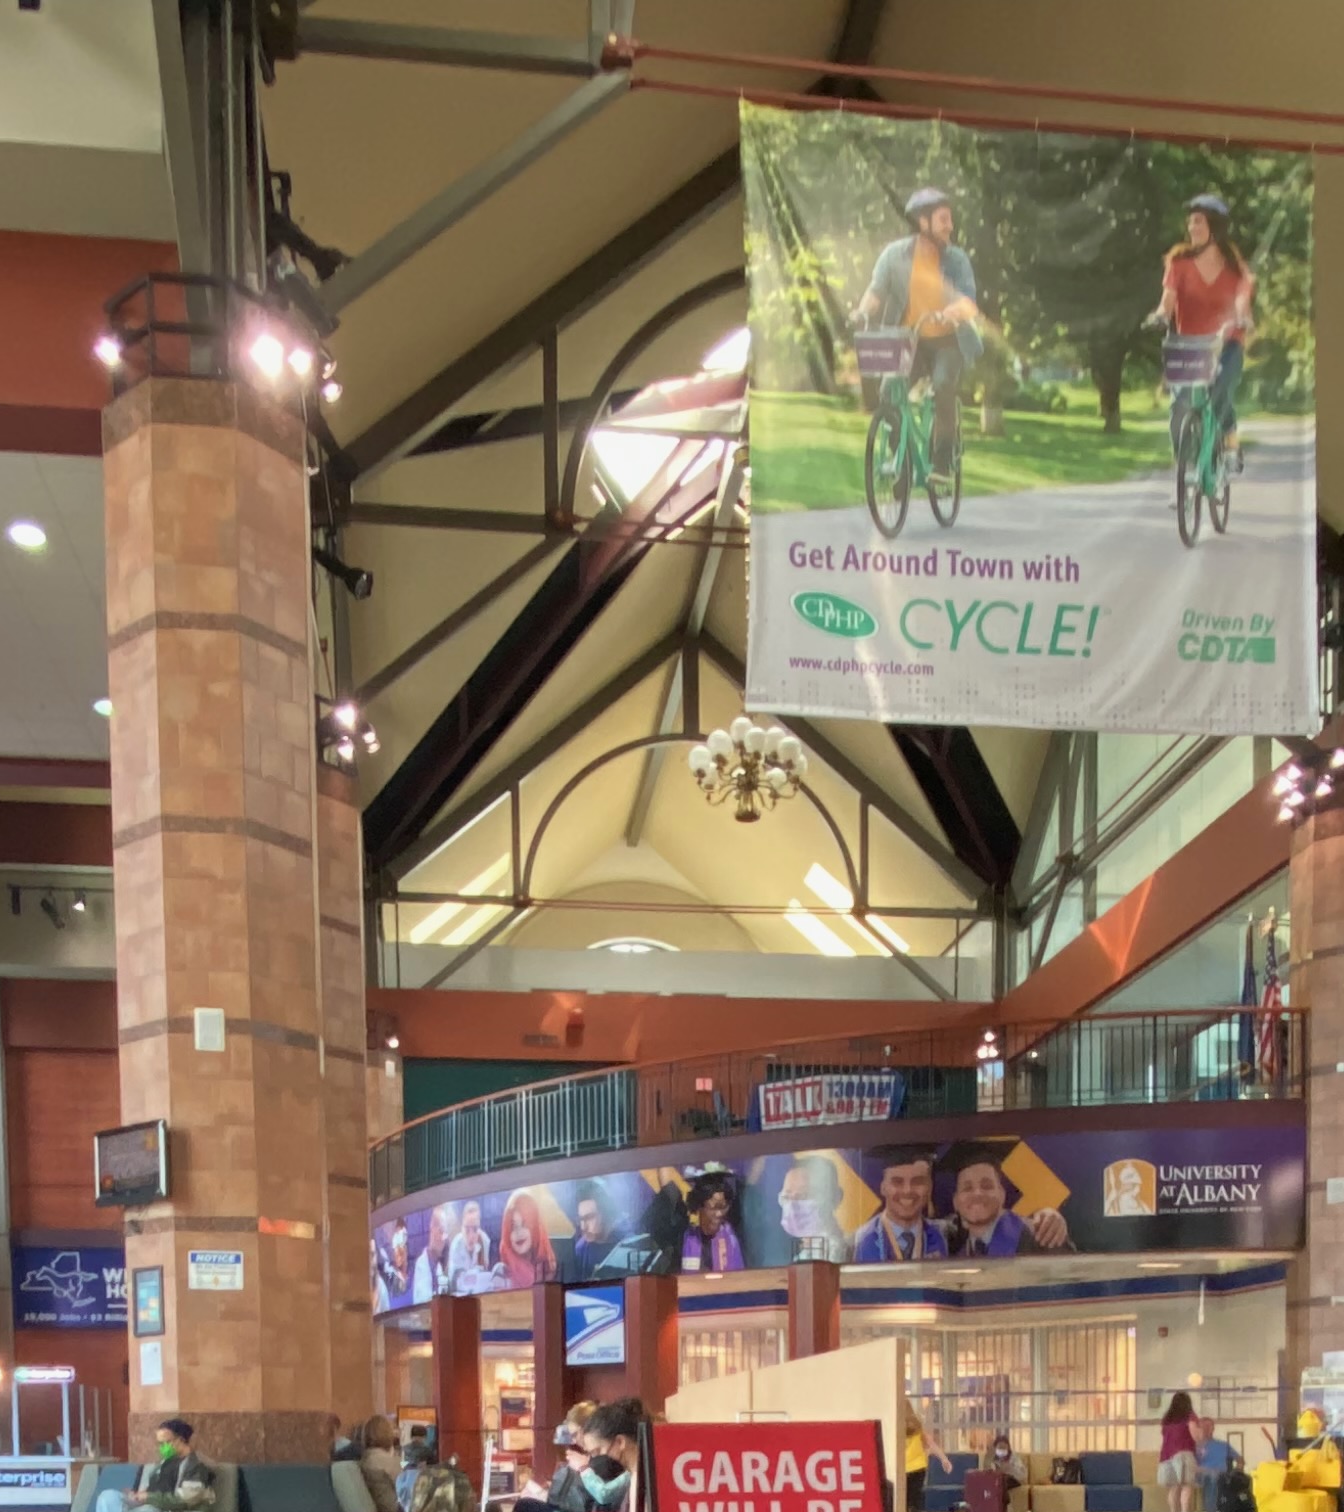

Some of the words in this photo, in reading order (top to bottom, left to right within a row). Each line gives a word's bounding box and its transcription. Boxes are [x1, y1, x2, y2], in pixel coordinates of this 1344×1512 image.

[789, 541, 834, 571] Get
[842, 544, 938, 576] Around
[946, 549, 1014, 579] Town
[1023, 554, 1080, 583] with
[802, 596, 864, 630] CDPHP
[1182, 608, 1243, 630] Driven
[1249, 613, 1274, 637] By
[900, 599, 1100, 658] CYCLE!
[1177, 633, 1276, 663] CDTA
[789, 656, 934, 676] www.cdphpcycle.com
[1160, 1165, 1262, 1182] UNIVERSITY
[1160, 1187, 1175, 1197] AT
[1173, 1183, 1260, 1206] ALBANY
[195, 1254, 236, 1263] NOTICE
[672, 1451, 865, 1493] GARAGE
